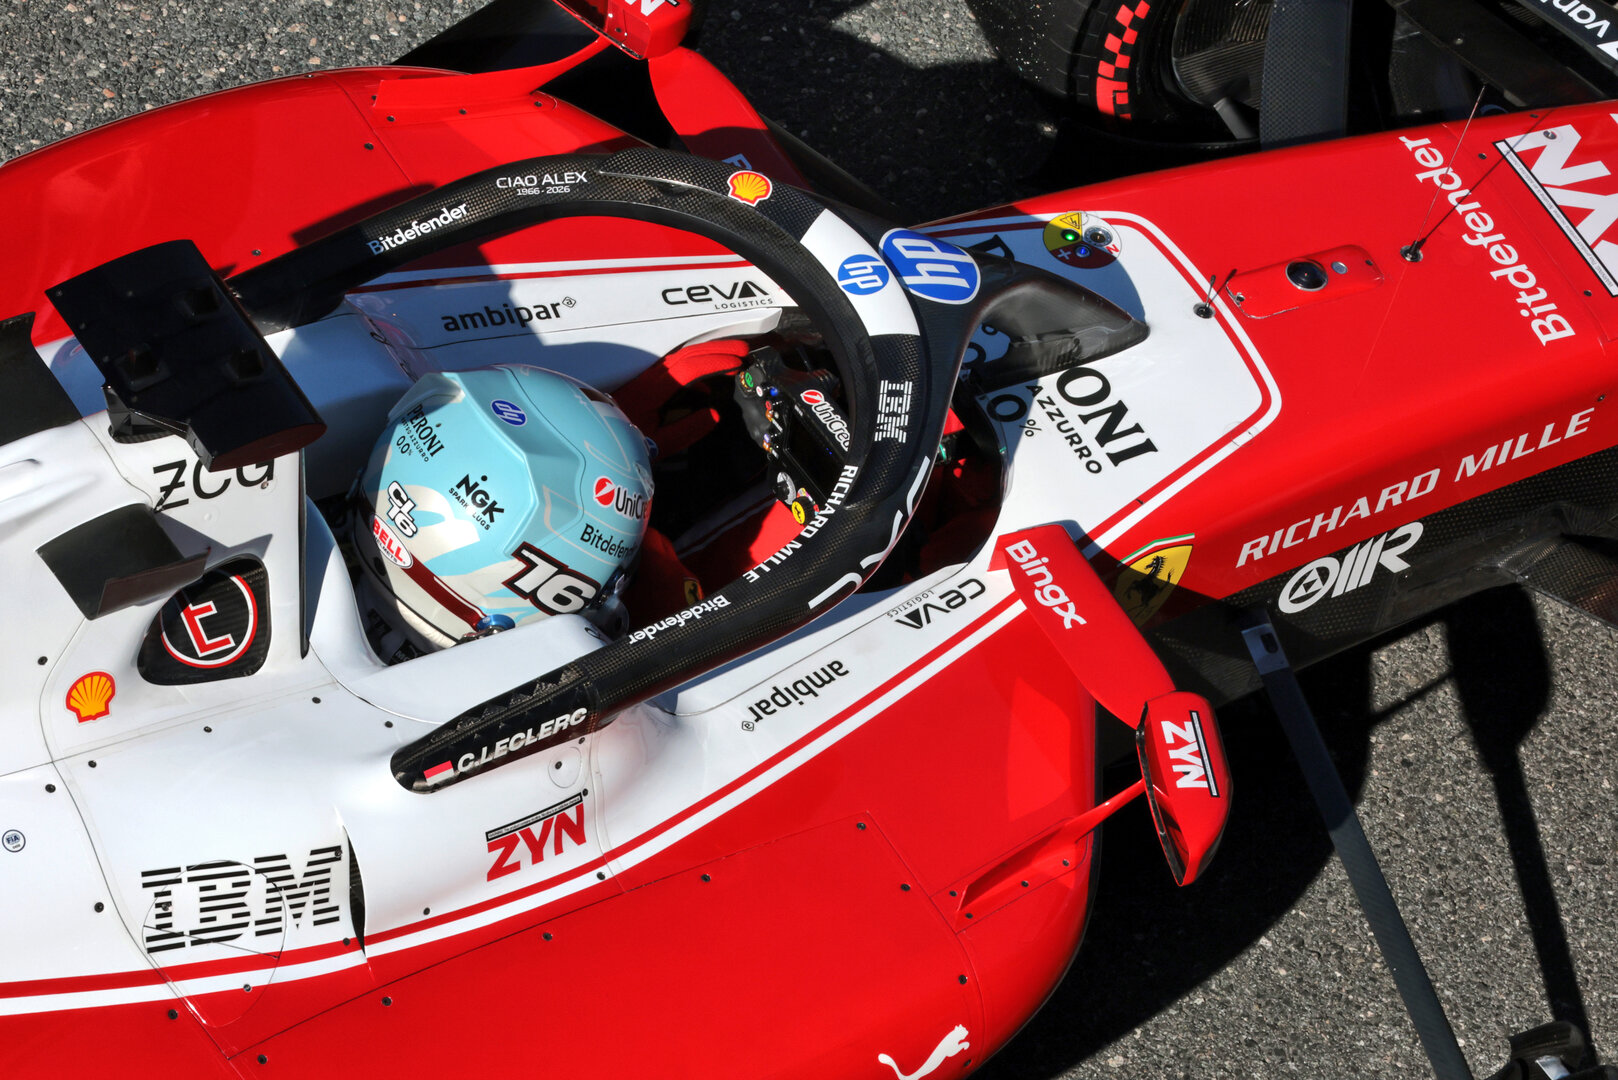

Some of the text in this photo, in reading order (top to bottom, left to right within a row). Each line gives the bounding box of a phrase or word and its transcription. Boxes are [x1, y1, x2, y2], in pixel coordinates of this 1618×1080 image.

[1541, 0, 1610, 38] van
[496, 171, 588, 189] CIAO ALEX
[516, 187, 540, 196] 1966
[546, 185, 571, 194] 2026
[367, 202, 470, 256] Bitdefender
[1398, 135, 1576, 347] Bitdefender
[838, 254, 889, 295] hp
[441, 299, 561, 332] ambipar
[714, 298, 774, 310] LOGISTICS
[407, 403, 445, 458] PERONI
[874, 379, 913, 443] IBM
[1025, 385, 1103, 475] AZZURRO
[455, 473, 505, 524] NGK
[1236, 407, 1596, 570] RICHARD MILLE
[372, 518, 404, 563] BELL
[471, 510, 491, 531] LUGS
[742, 465, 859, 583] RICHARD MILLE
[507, 543, 601, 616] 16
[885, 589, 935, 619] LOGISTICS
[628, 594, 731, 646] Bitdefender
[748, 660, 850, 723] ambipar
[456, 707, 589, 774] C.LECLERC
[1160, 720, 1209, 789] ZYN
[487, 802, 587, 883] ZYN
[141, 845, 342, 954] IBM
